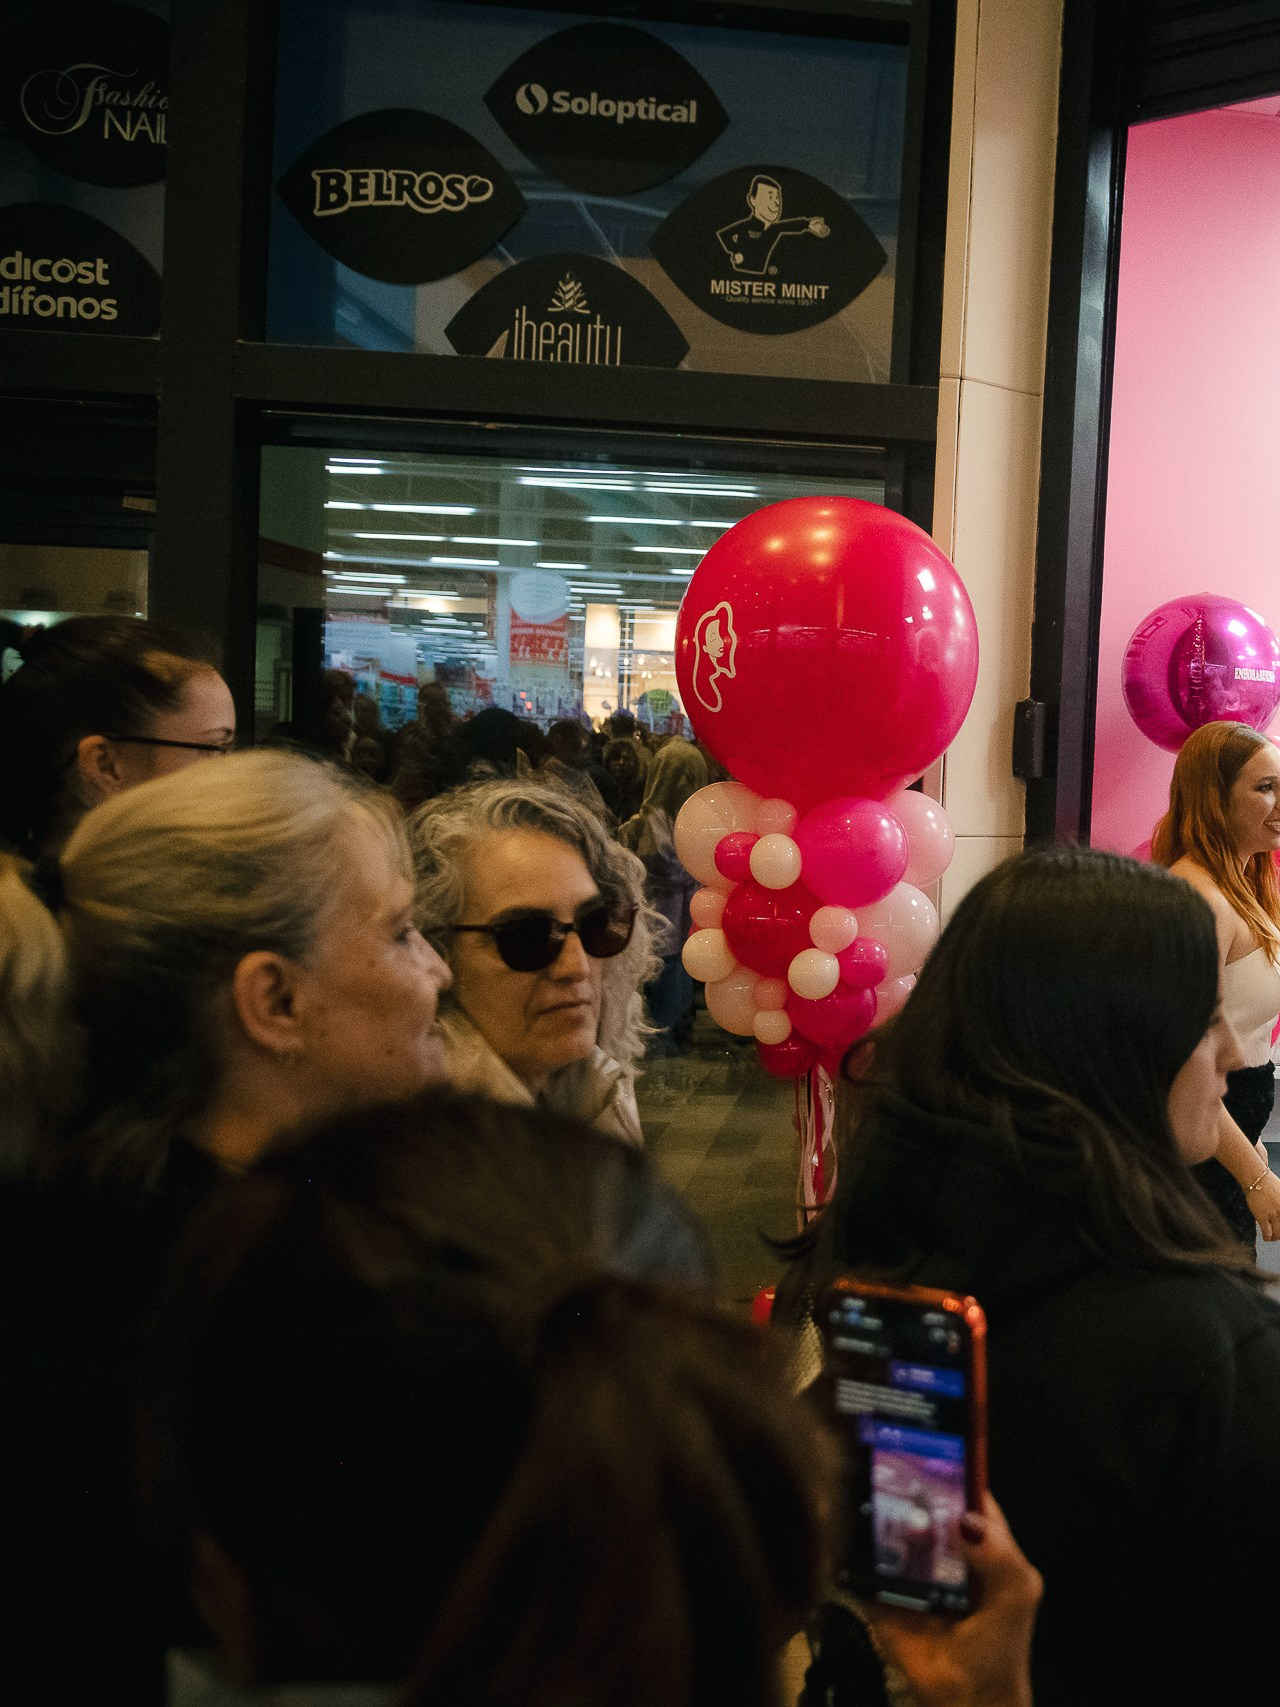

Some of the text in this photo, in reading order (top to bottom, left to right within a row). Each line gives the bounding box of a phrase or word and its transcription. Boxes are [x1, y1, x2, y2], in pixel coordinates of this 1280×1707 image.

[552, 91, 697, 124] Soloptical
[711, 279, 829, 299] MISTER MINIT
